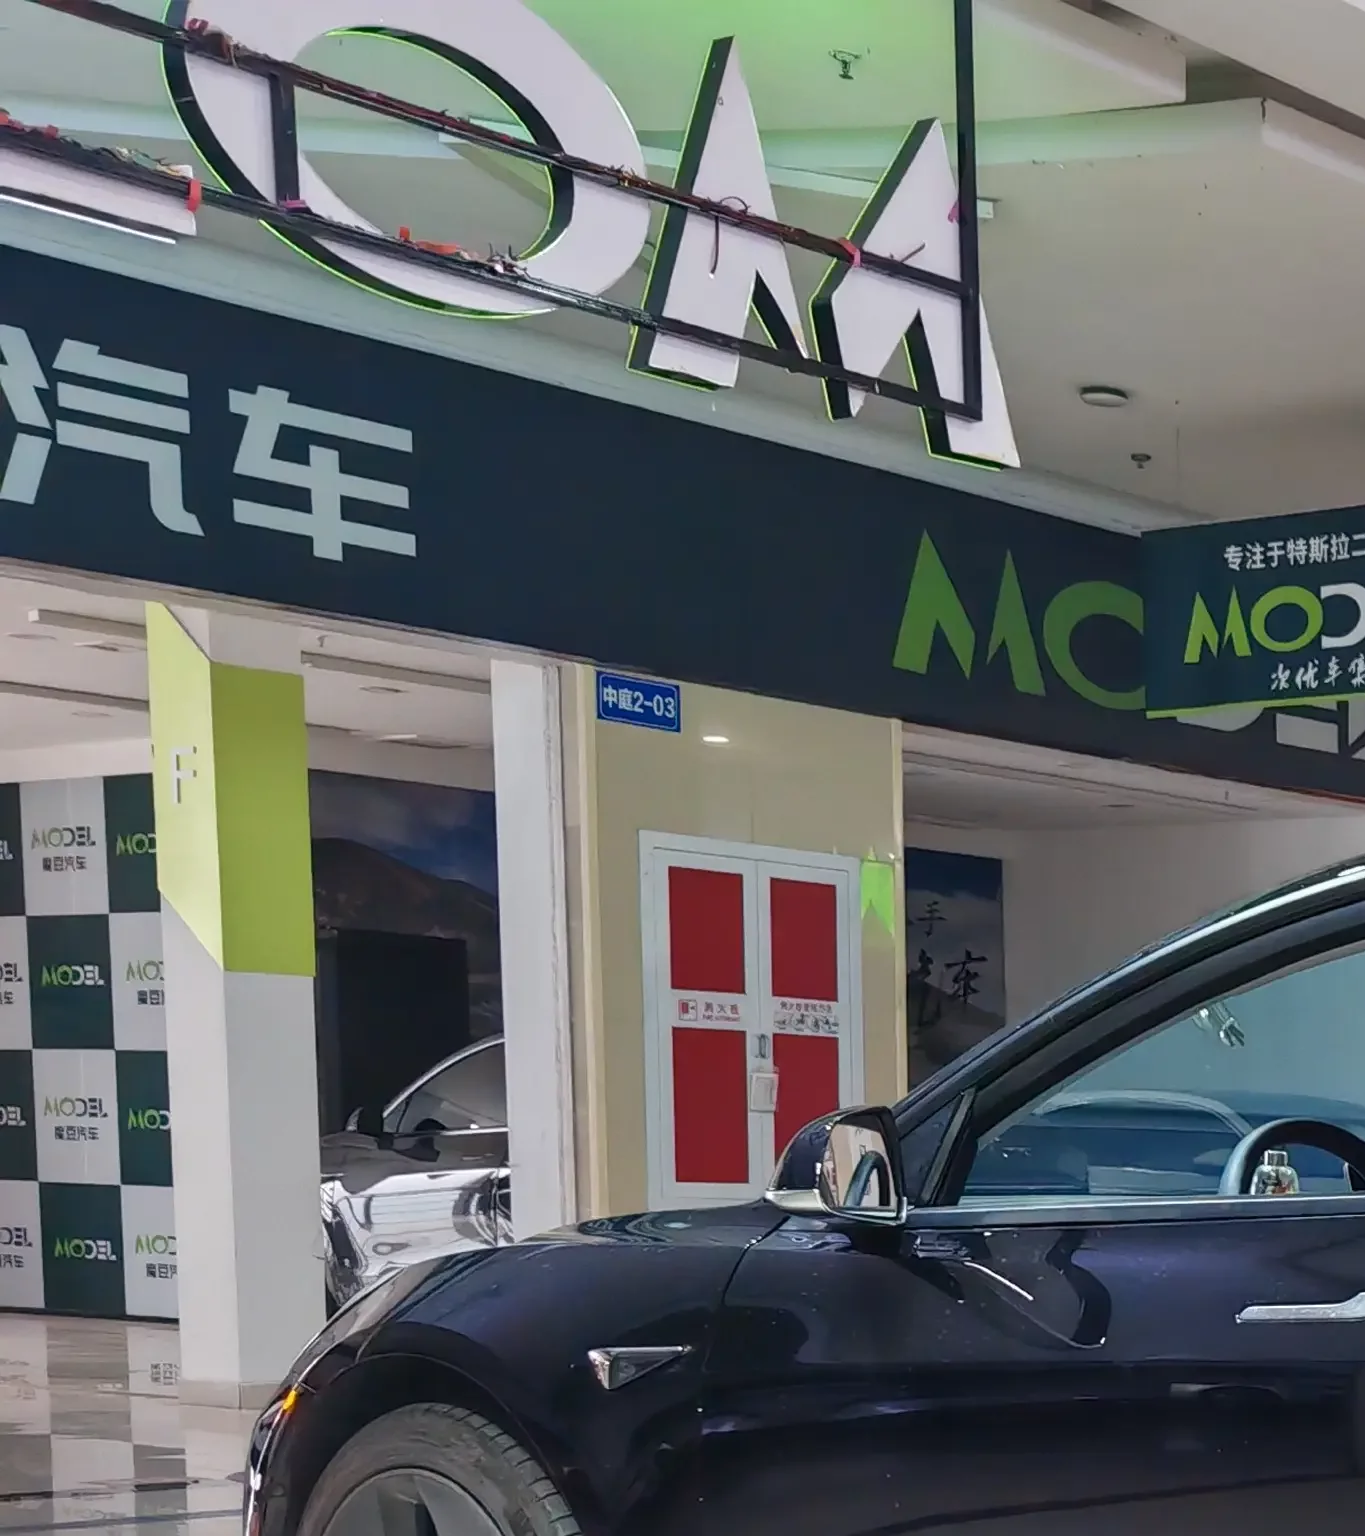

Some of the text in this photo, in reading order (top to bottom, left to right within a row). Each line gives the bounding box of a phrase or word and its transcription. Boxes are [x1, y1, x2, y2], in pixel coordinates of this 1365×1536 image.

[0, 323, 417, 562] 汽车
[603, 684, 675, 718] 中庭2-03
[170, 746, 197, 804] F
[31, 826, 96, 849] MODEL
[41, 964, 105, 987] MODEL
[44, 1096, 108, 1118] MODEL
[54, 1237, 117, 1261] MODEL
